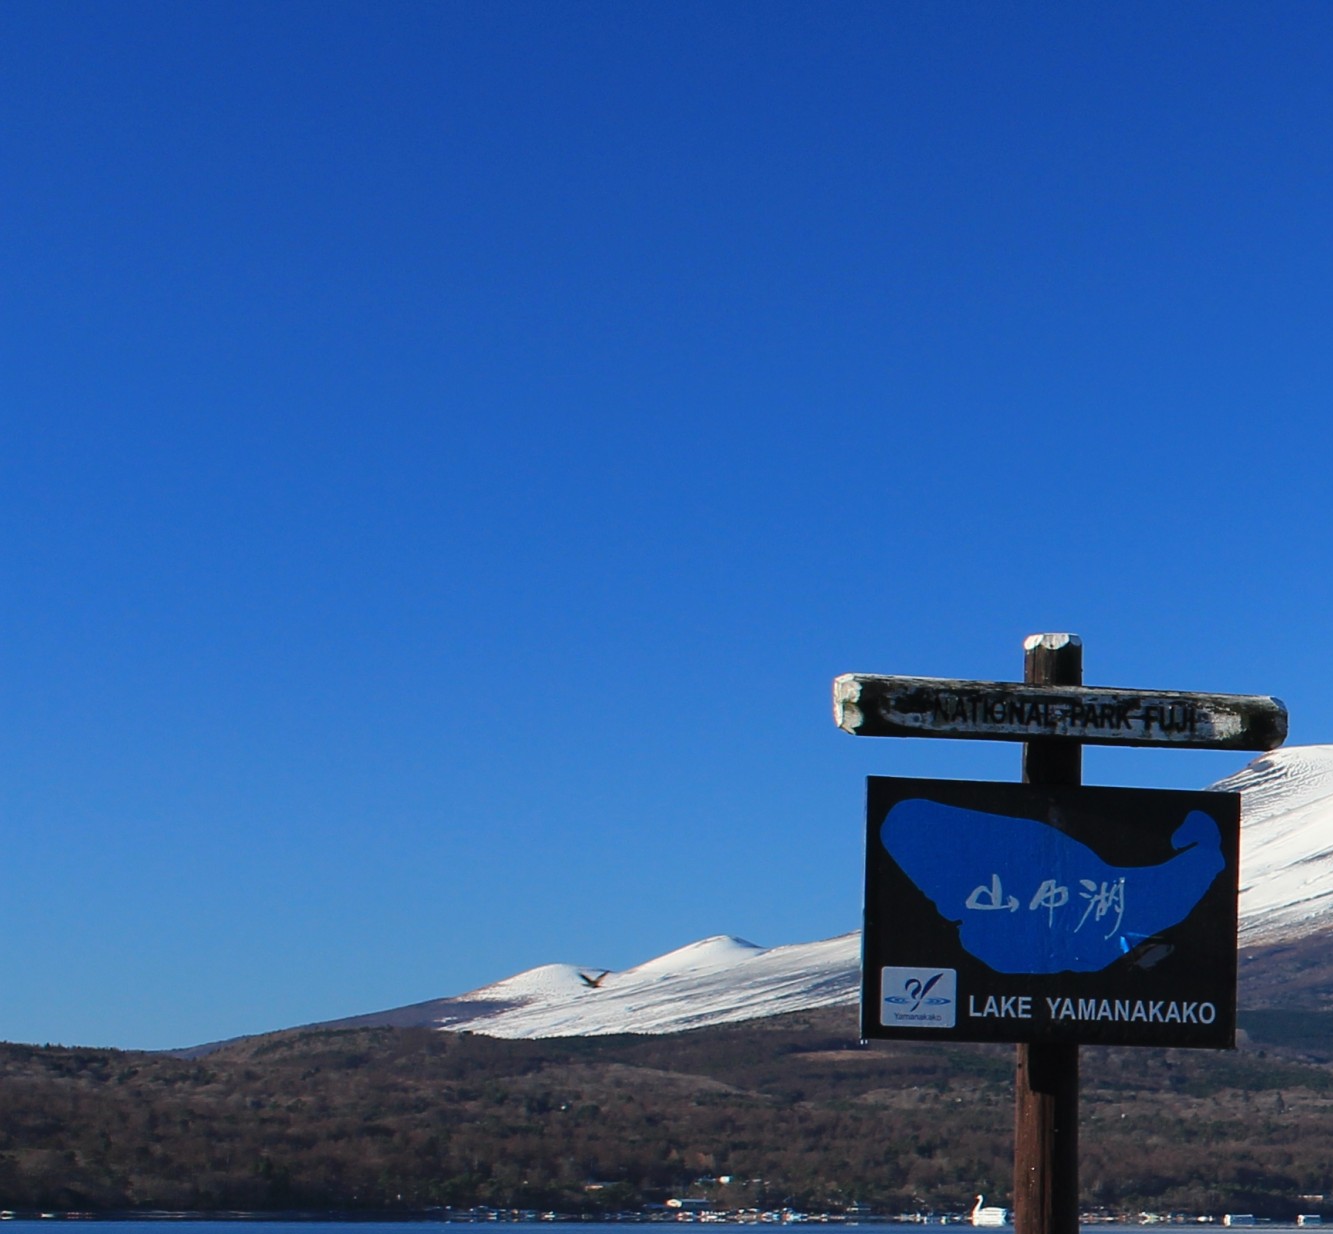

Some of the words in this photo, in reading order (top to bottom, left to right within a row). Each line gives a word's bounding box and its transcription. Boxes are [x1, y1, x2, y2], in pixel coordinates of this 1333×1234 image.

[932, 694, 1057, 729] NATIONAL
[1070, 700, 1132, 730] PARK
[1144, 705, 1197, 732] FUJI
[966, 873, 1126, 940] 山中湖
[894, 1011, 942, 1022] Yamanakako
[969, 994, 1032, 1018] LAKE
[1046, 996, 1216, 1024] YAMANAKAKO
